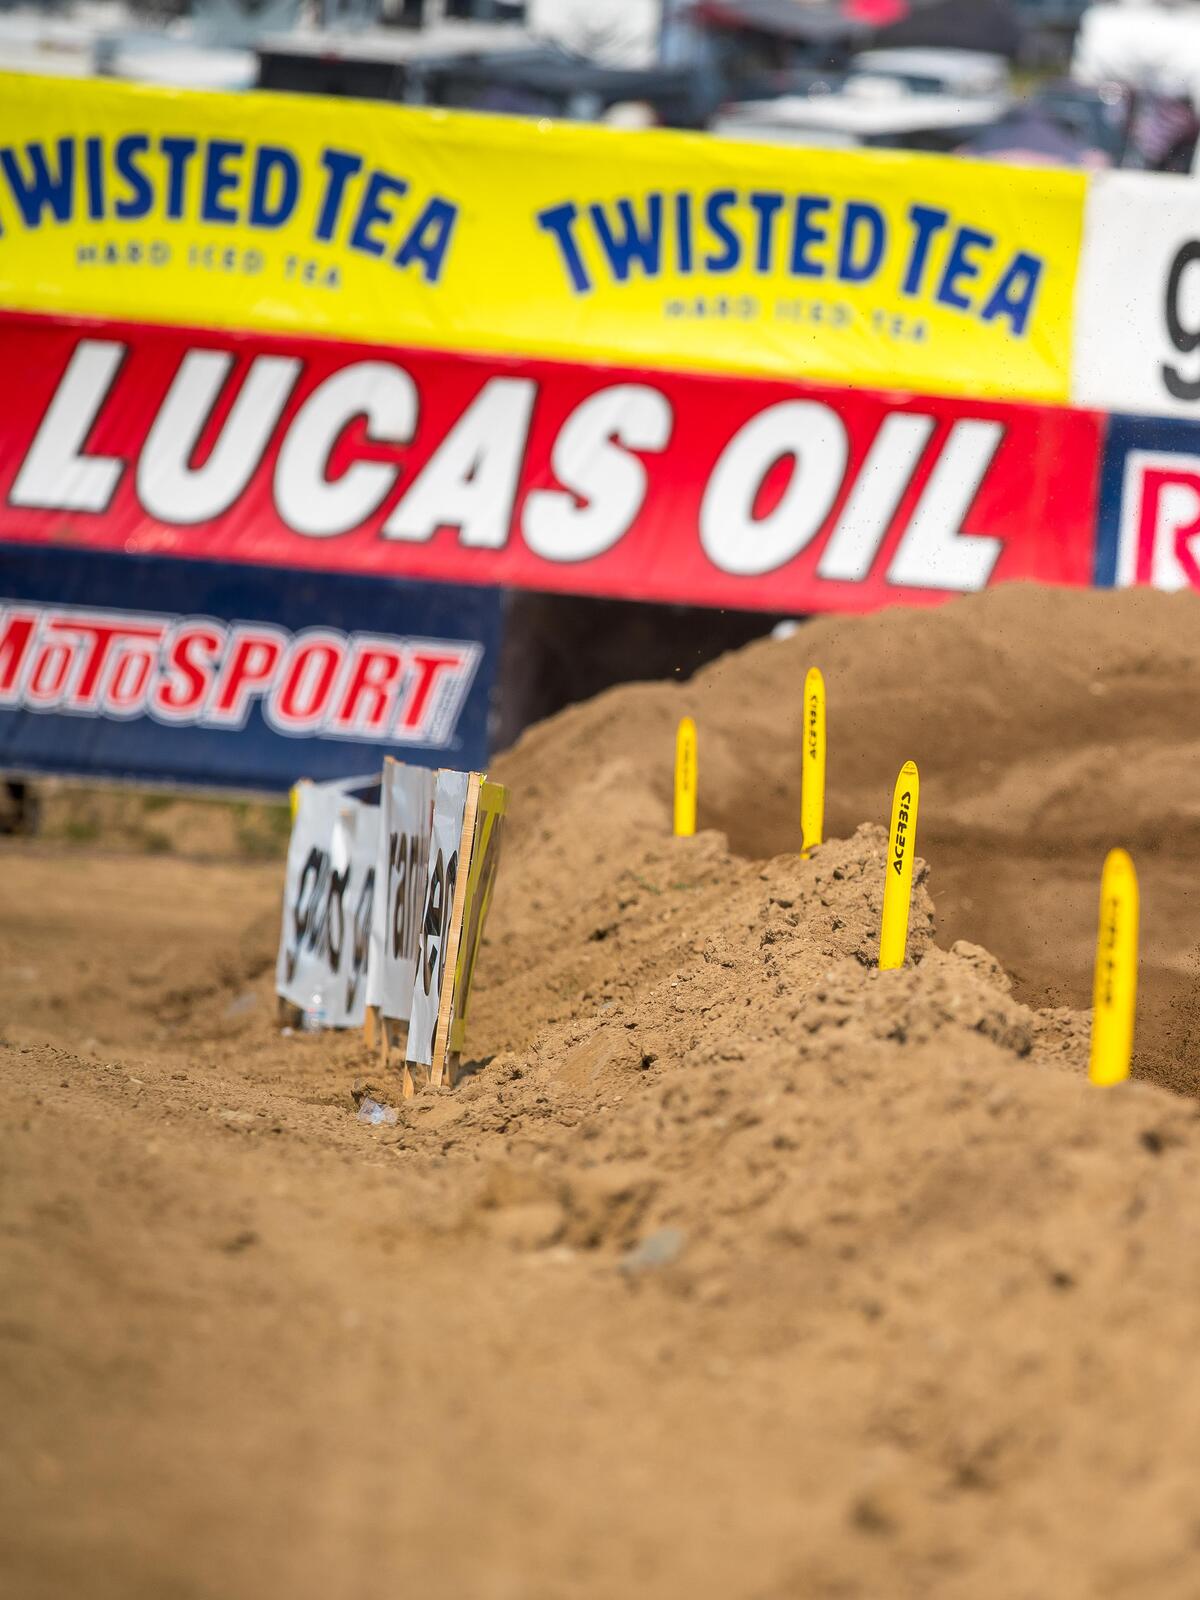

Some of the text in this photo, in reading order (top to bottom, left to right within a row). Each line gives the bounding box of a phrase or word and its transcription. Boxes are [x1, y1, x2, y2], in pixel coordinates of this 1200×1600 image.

[0, 134, 459, 284] WISTED TEA
[536, 189, 1044, 337] TWISTED TEA
[9, 337, 1006, 593] LUCAS OIL
[893, 791, 912, 876] ACERBIS
